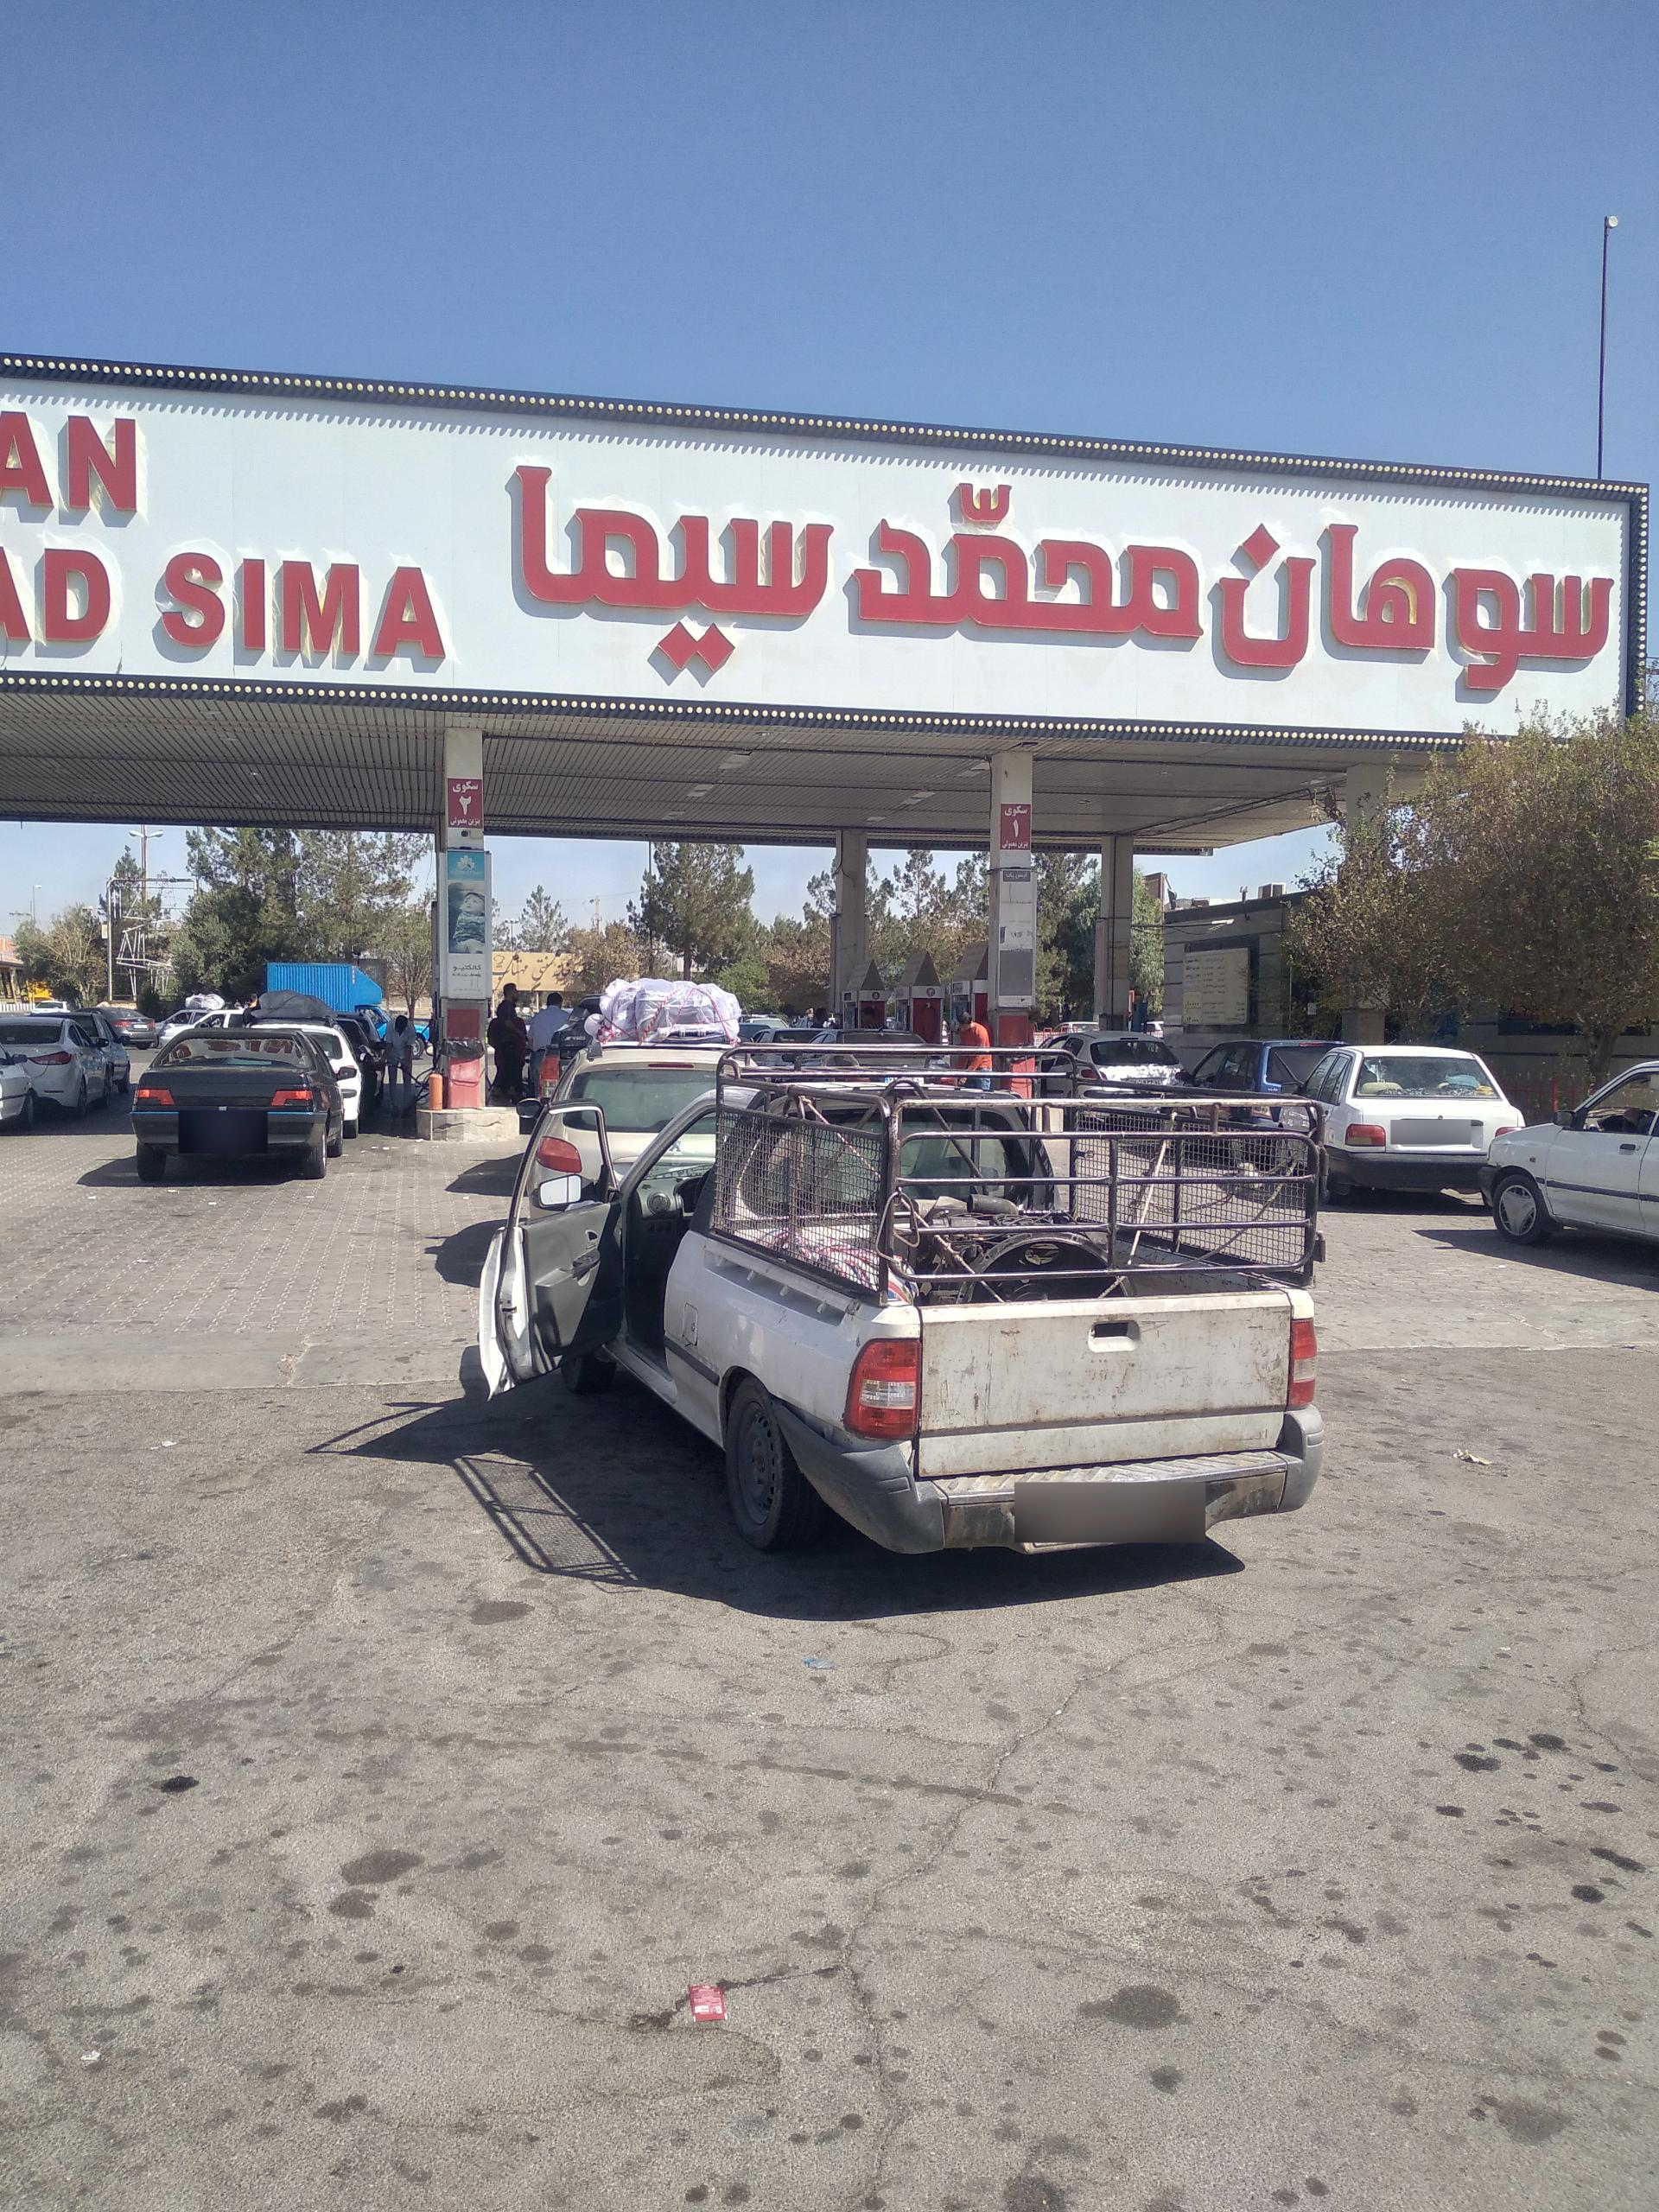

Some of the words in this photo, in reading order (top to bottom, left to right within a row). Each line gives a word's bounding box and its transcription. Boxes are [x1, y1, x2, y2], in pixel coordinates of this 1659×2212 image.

[516, 466, 835, 671] سیما
[162, 552, 446, 658] SIMA
[1220, 523, 1614, 690] سوهان
[452, 780, 479, 793] سکوی
[459, 795, 472, 816] ۲
[1004, 805, 1028, 817] سکوی
